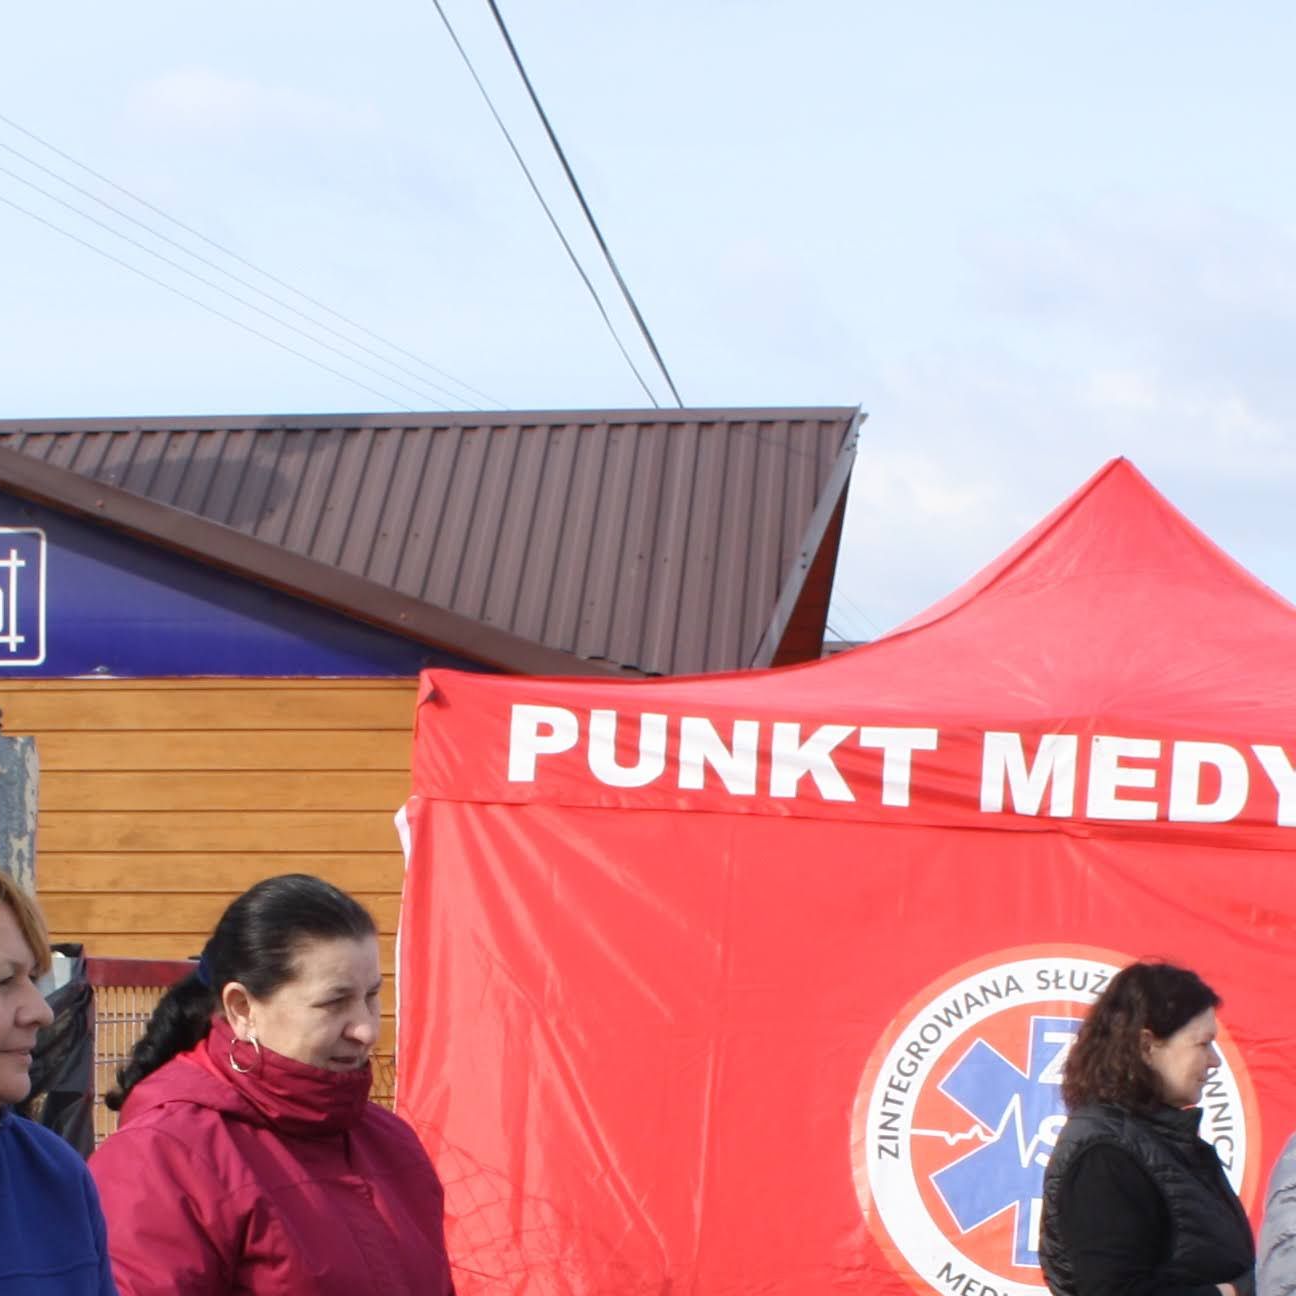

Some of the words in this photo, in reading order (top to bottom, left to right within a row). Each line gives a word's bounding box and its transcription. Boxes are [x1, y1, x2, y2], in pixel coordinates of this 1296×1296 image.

[507, 703, 939, 807] PUNKT
[877, 974, 1024, 1160] ZINTEGROWANA
[1036, 968, 1109, 996] SŁUŻ
